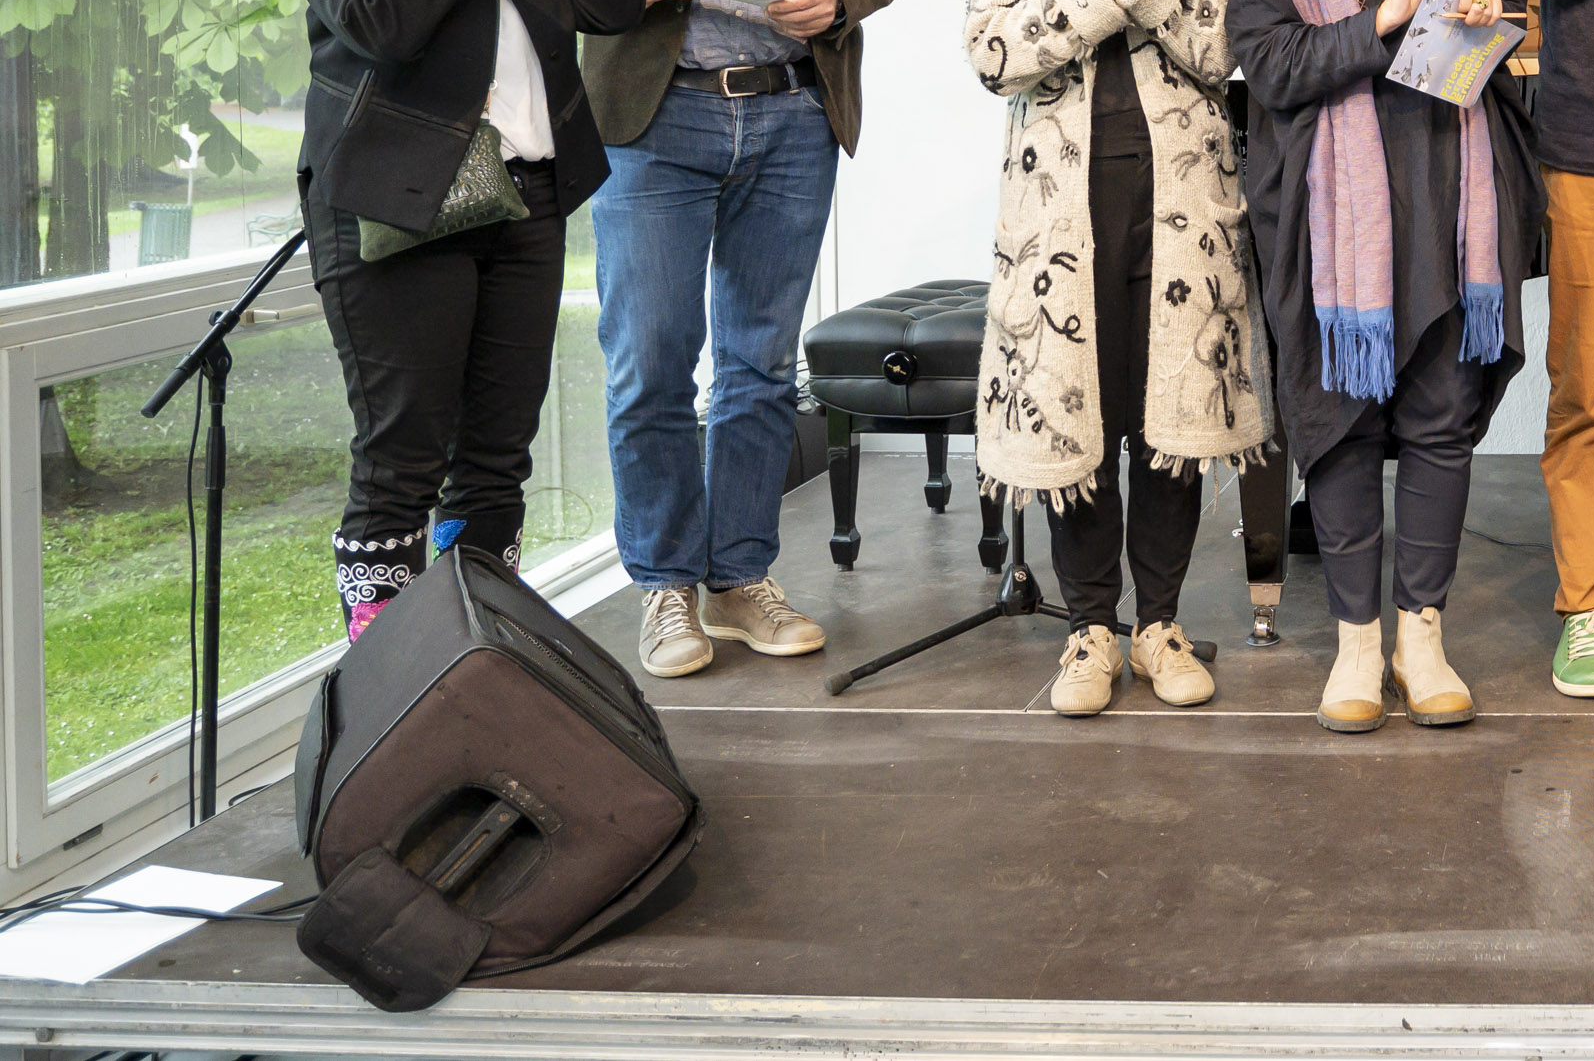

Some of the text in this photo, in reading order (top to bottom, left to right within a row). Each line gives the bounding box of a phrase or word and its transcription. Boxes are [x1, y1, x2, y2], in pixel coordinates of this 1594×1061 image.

[1440, 54, 1467, 97] Friede
[1448, 47, 1480, 100] braucht
[1455, 33, 1505, 103] Erinnerung
